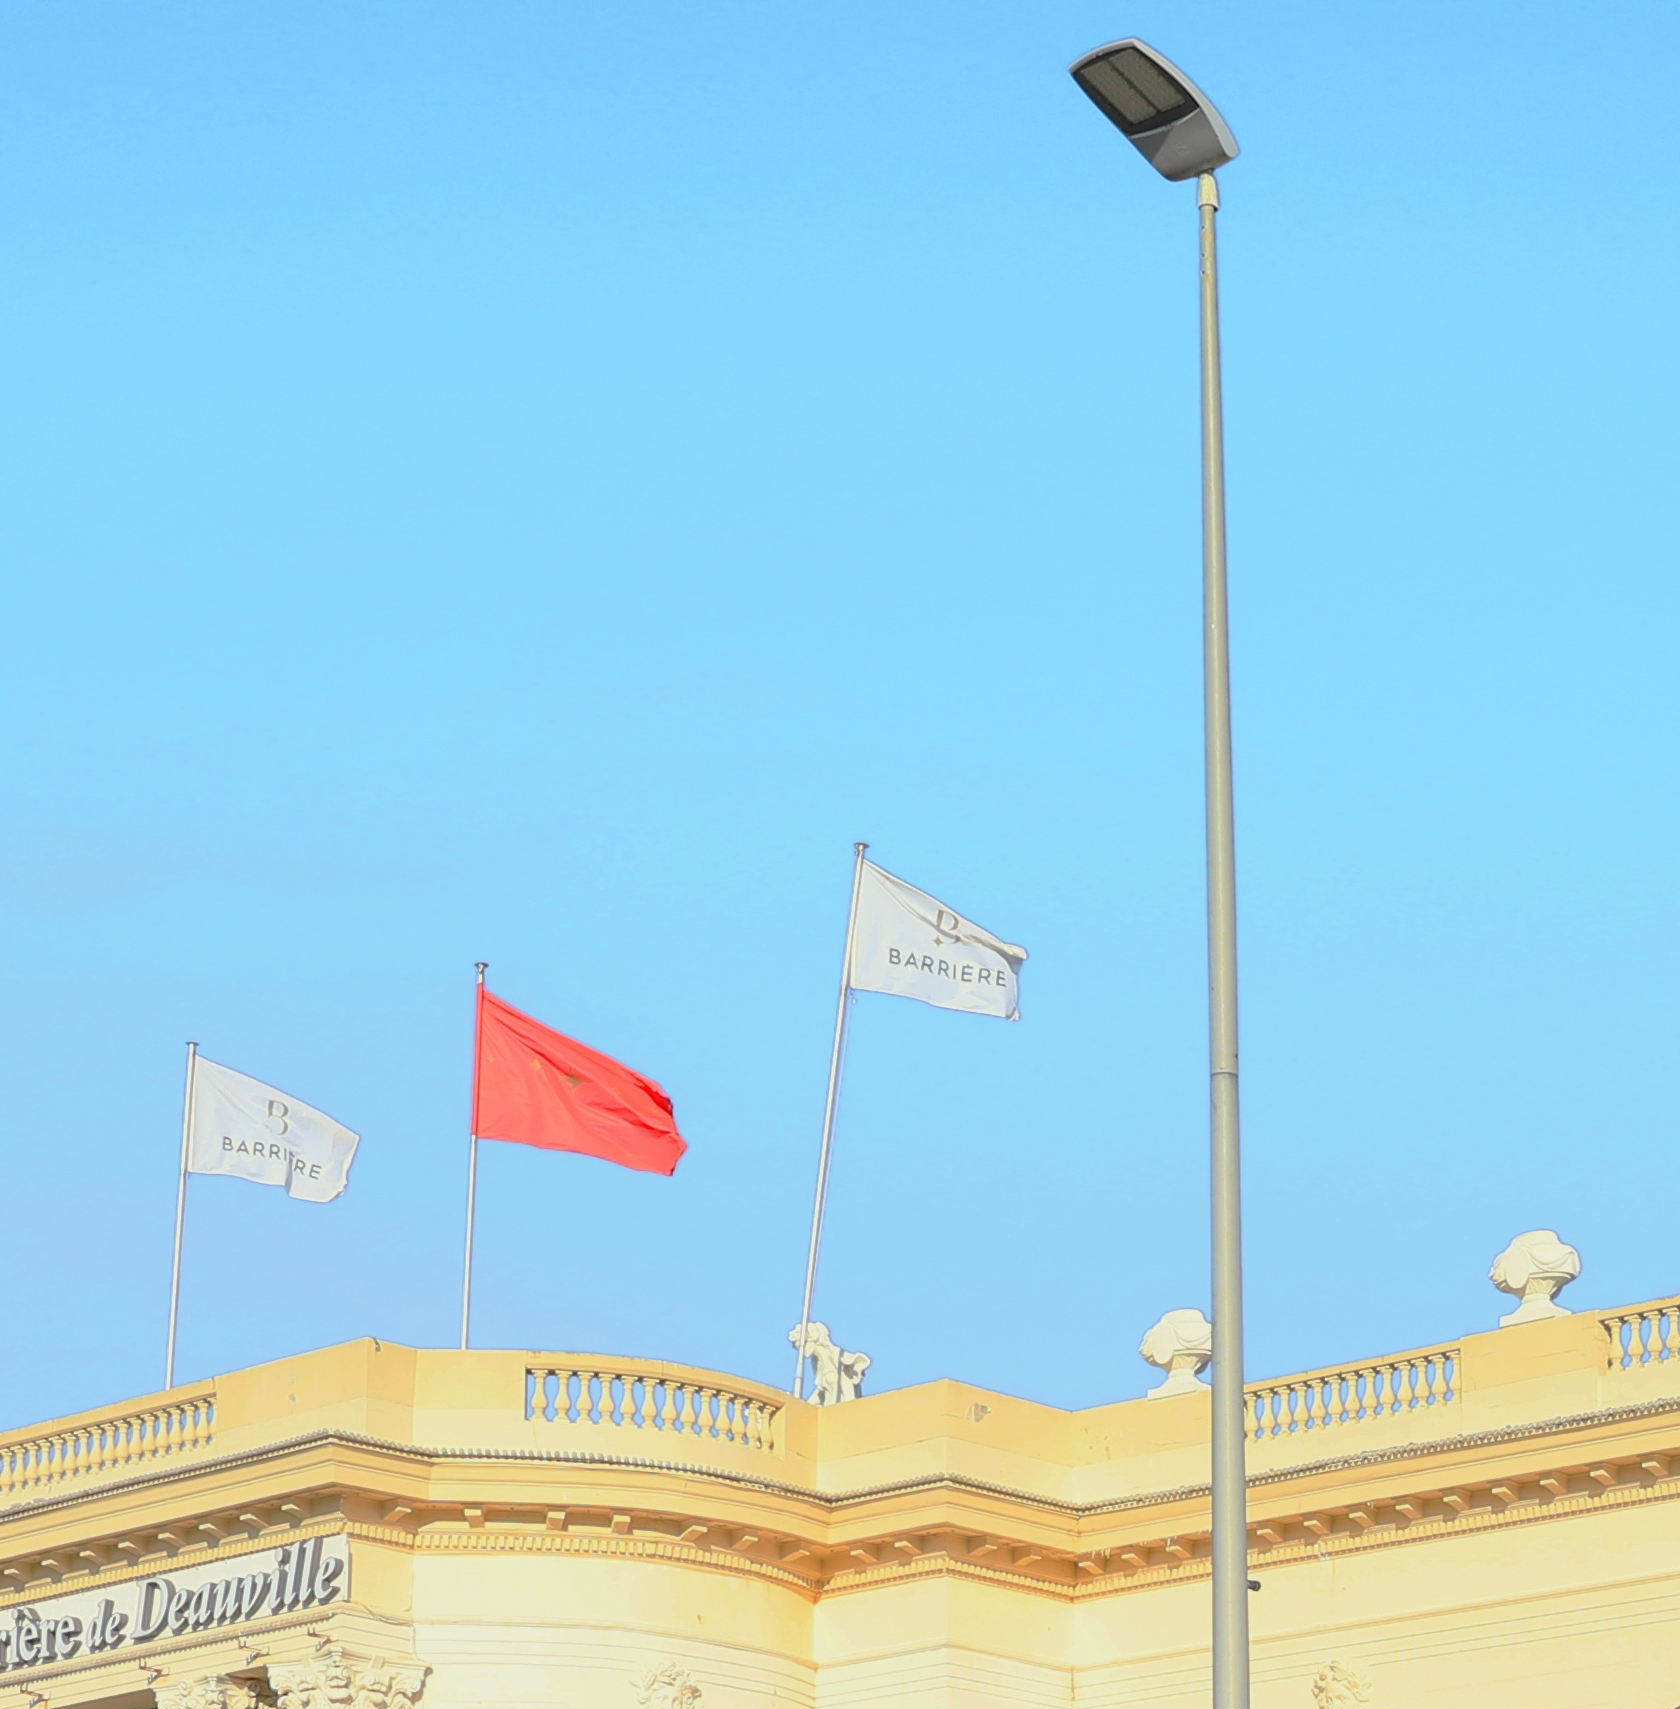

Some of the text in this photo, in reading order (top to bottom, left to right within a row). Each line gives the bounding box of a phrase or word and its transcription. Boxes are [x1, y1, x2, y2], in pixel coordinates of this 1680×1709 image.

[889, 947, 1007, 988] BARRIÈRE
[222, 1136, 322, 1180] BARRIRE
[85, 1599, 124, 1651] de
[132, 1538, 343, 1642] Deauville
